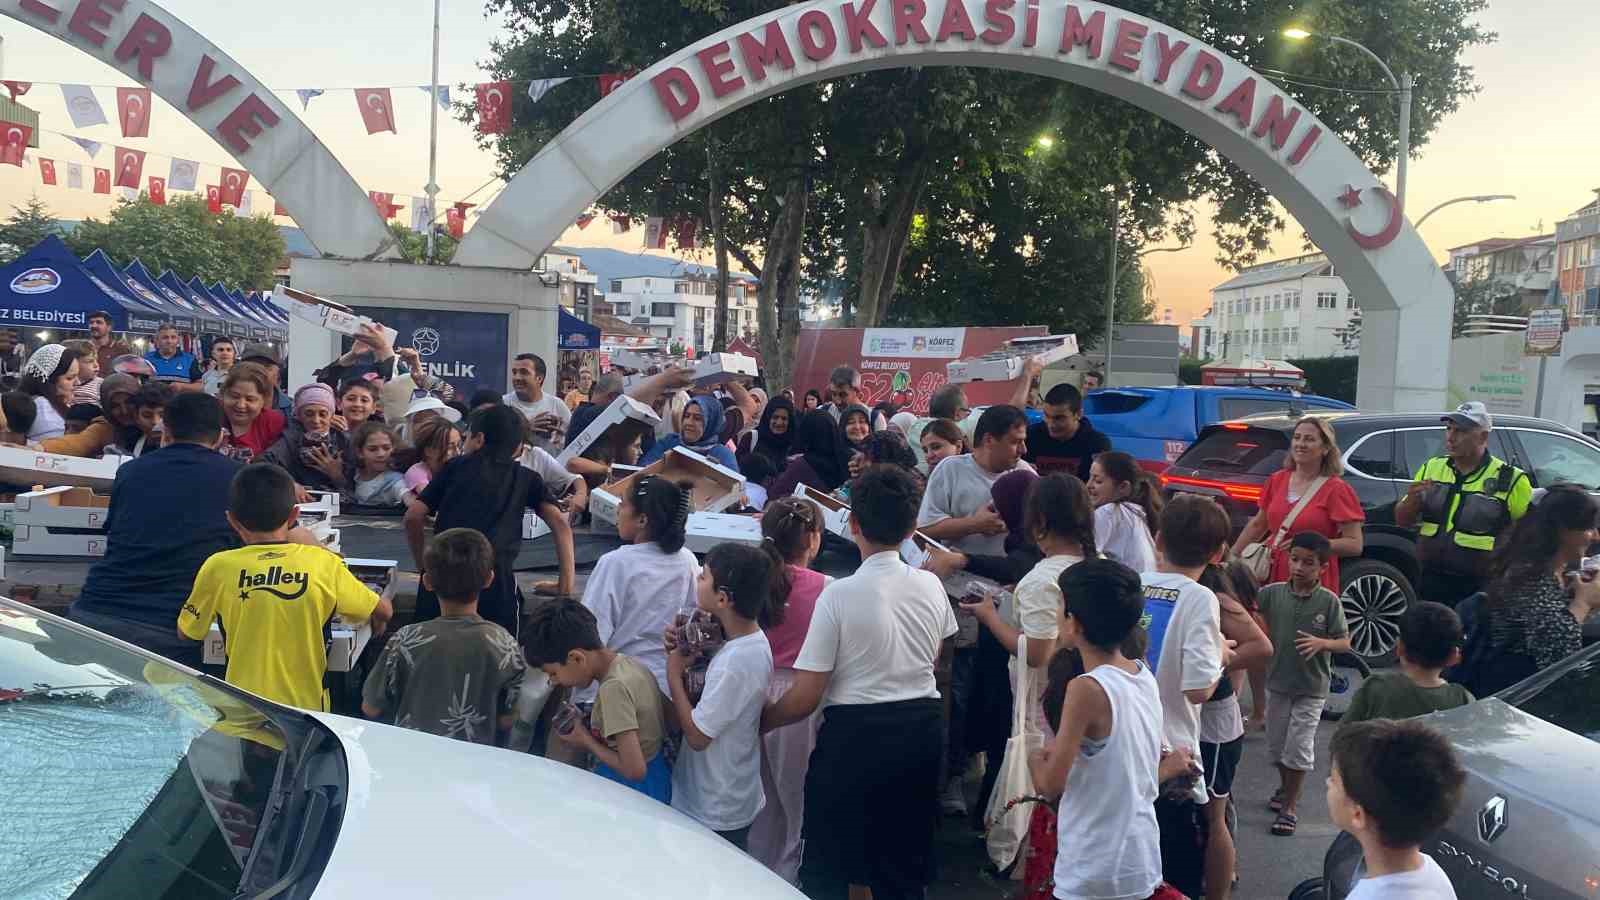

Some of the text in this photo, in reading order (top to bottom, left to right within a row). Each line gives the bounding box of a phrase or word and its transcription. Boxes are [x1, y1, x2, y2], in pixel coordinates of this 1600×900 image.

[651, 0, 1322, 165] DEMOKRASİ MEYDANI
[186, 54, 281, 153] VE
[13, 309, 85, 324] BELEDİYESİ
[420, 361, 476, 378] ENLİK
[1168, 442, 1184, 453] 112
[238, 566, 308, 599] halley
